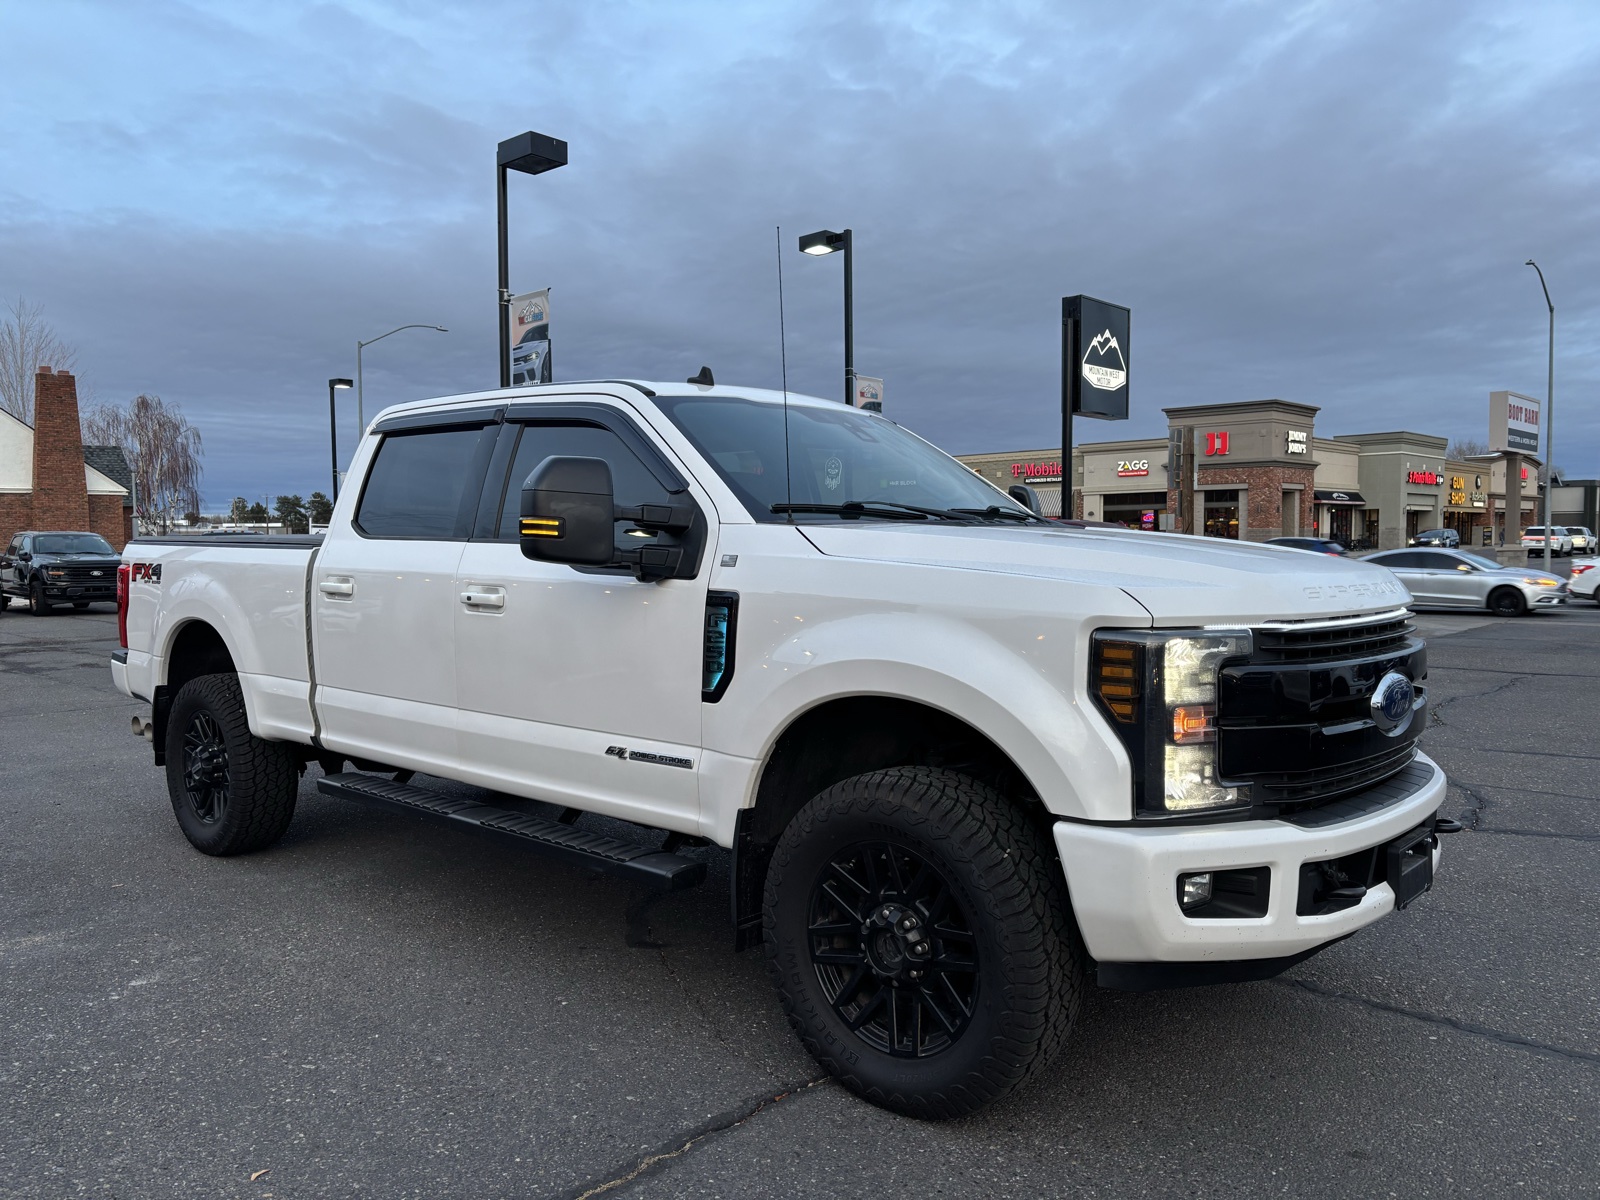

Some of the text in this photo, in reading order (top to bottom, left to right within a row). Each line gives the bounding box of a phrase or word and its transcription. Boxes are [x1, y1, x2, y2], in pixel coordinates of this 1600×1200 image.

[1088, 366, 1120, 379] MOUNTAIN WEST
[1096, 377, 1111, 386] MOTOR
[1508, 403, 1538, 425] BOOT BARN
[1287, 430, 1307, 441] JIMMY
[1287, 442, 1307, 454] JOHN'S
[1117, 459, 1149, 471] ZAGG
[1453, 477, 1465, 489] GUN
[1451, 492, 1466, 504] SHOP
[131, 563, 162, 582] FX4
[630, 750, 657, 760] POWER
[658, 754, 691, 766] STROKE
[784, 937, 862, 1066] BLACKHAWK
